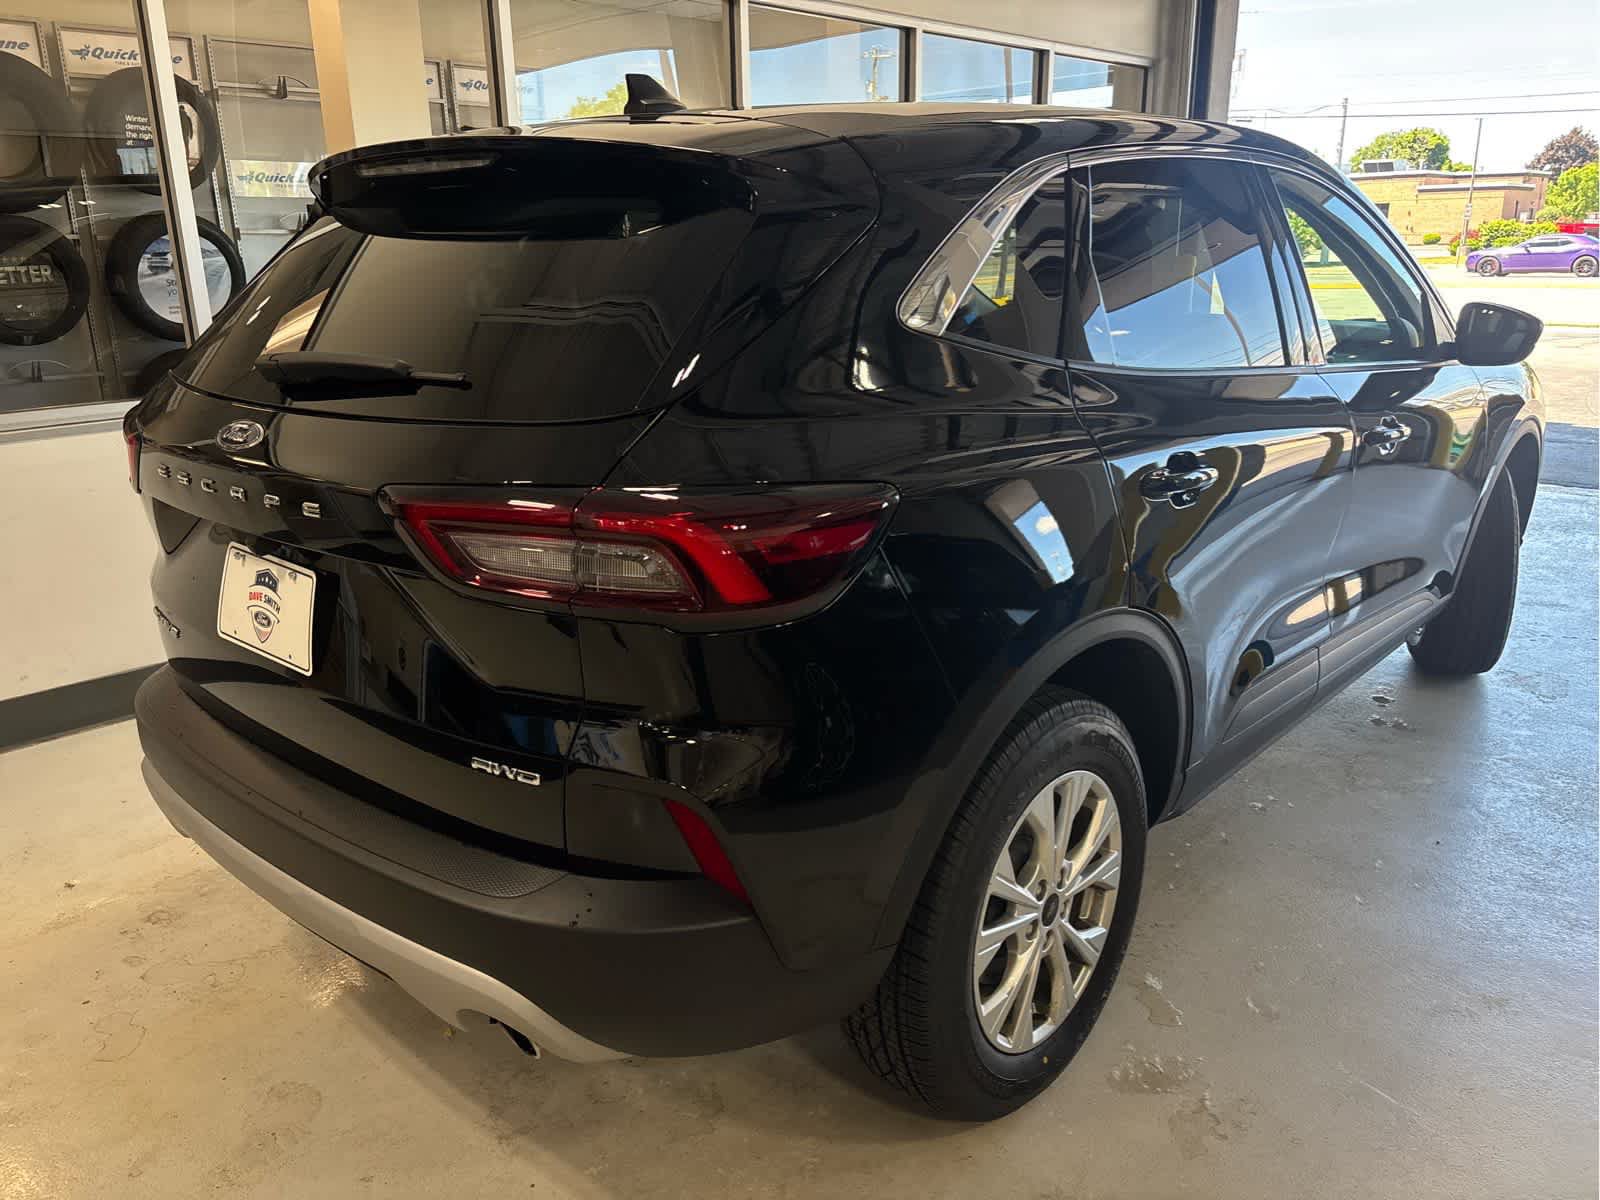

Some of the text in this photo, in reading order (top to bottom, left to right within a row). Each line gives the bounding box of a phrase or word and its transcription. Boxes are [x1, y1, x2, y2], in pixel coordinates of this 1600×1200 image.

[92, 46, 140, 61] Quick
[125, 114, 148, 122] Winter
[139, 132, 153, 140] righ
[254, 171, 295, 184] Quick
[0, 265, 54, 284] ETTER
[167, 289, 177, 297] yo
[157, 464, 322, 518] ESCAPE
[249, 591, 281, 614] DAVE SMITH
[471, 757, 541, 786] AWD
